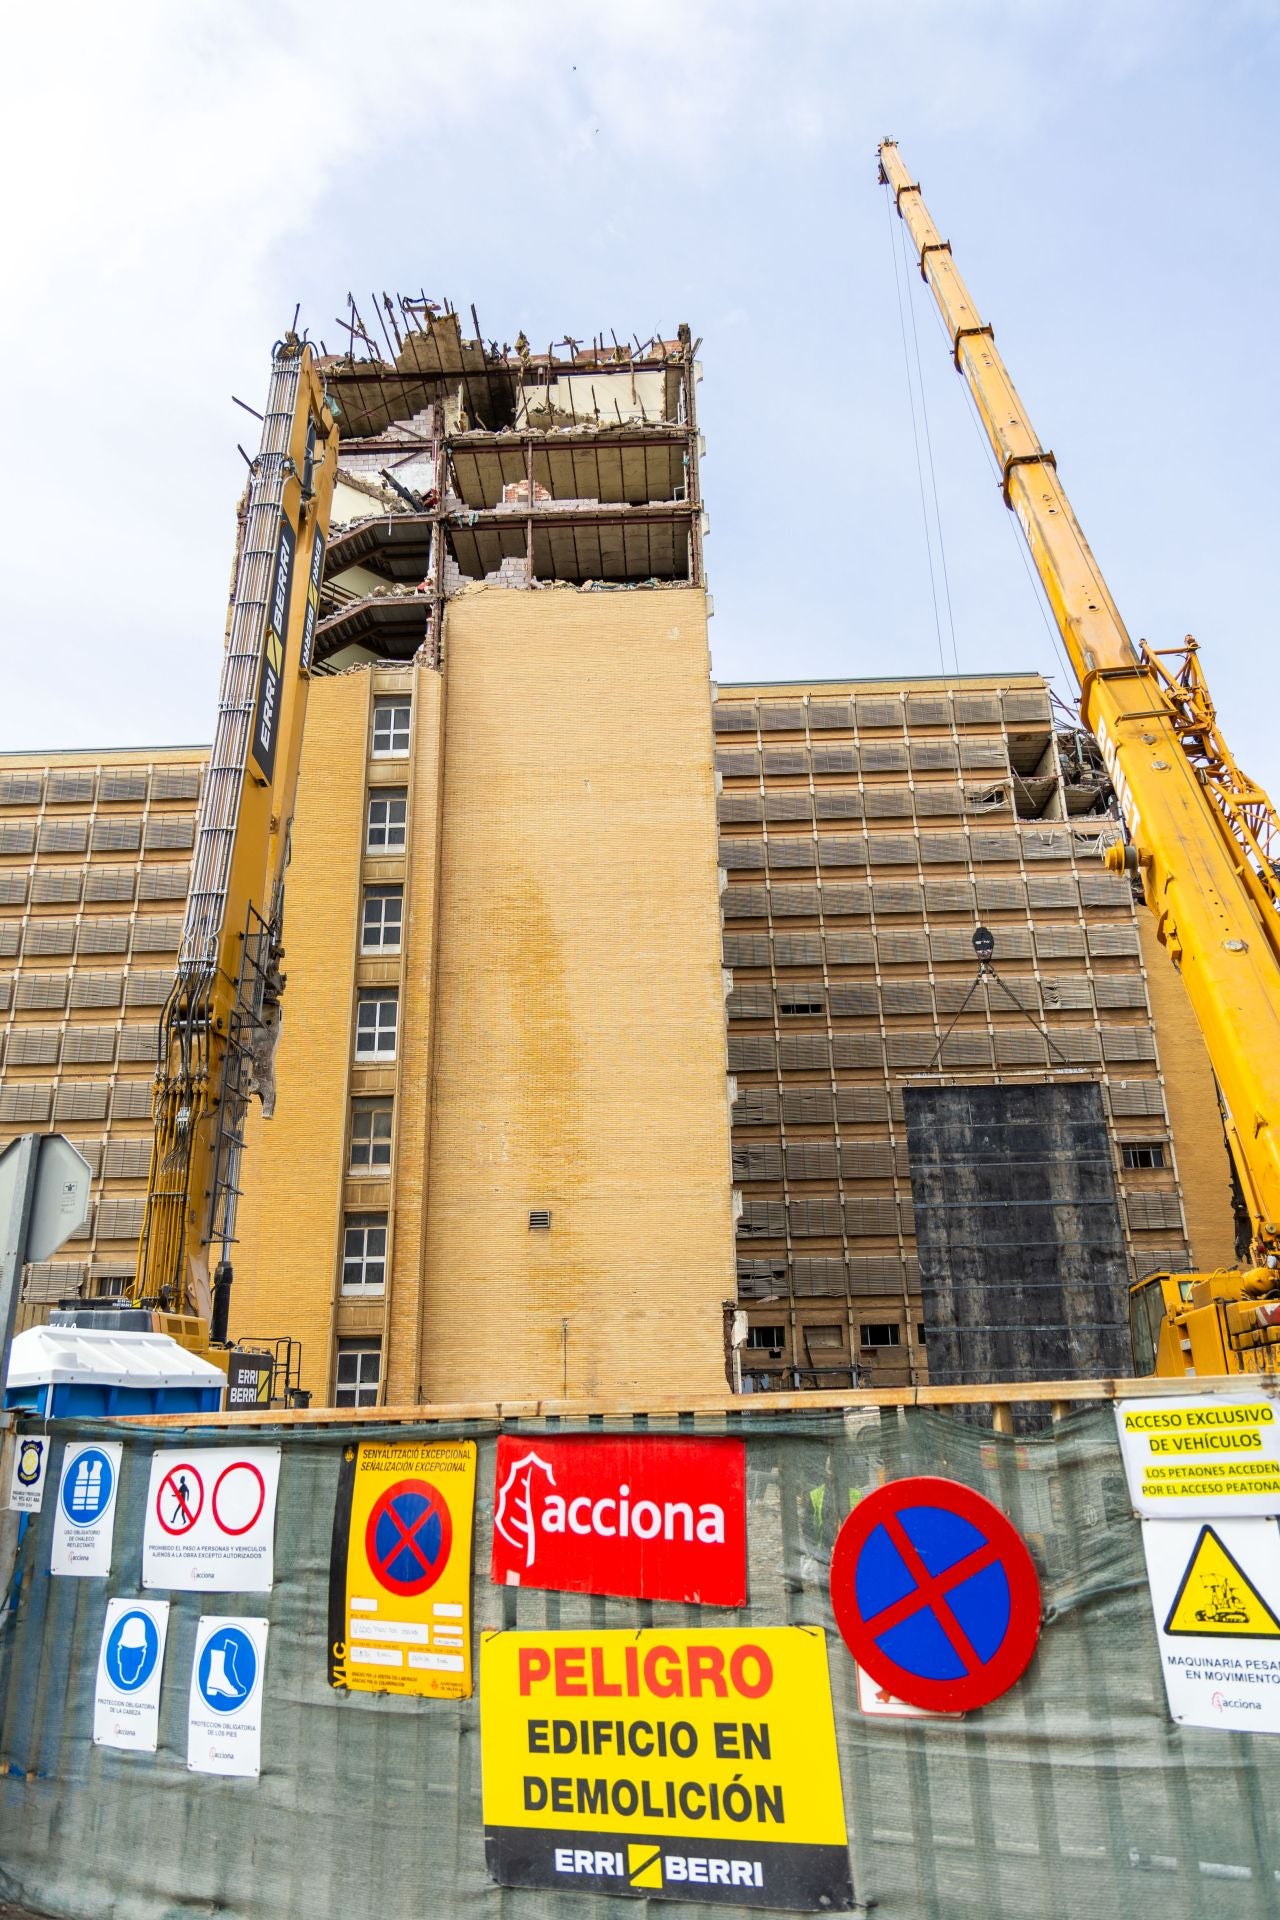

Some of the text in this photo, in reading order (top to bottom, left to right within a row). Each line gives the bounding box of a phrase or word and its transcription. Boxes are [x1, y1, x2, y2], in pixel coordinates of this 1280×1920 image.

[301, 537, 322, 667] ERRI BERRI
[260, 536, 291, 753] ERRI BERRI
[1097, 714, 1140, 839] BONET
[238, 1369, 258, 1384] ERRI
[230, 1388, 257, 1403] BERRI
[1125, 1408, 1273, 1429] ACCESO EXCLUSIVO
[1150, 1433, 1262, 1451] DE VEHÍCULOS
[363, 1448, 471, 1460] SENYALITZACIÓ EXCEPCIONAL
[361, 1461, 466, 1472] SEÑALIZACIÓN EXCEPCIONAL
[1146, 1464, 1280, 1478] LOS PETAONES ACCEDEN
[1142, 1481, 1280, 1495] POR EL ACCESO PEATONA
[541, 1484, 725, 1543] acciona
[333, 1642, 346, 1688] VLC
[1168, 1656, 1280, 1670] MAQUINARIA PESA
[518, 1644, 773, 1699] PELIGRO
[1186, 1670, 1280, 1684] EN MOVIMIENTO
[125, 1702, 155, 1710] OBLIGATORIA
[1223, 1698, 1262, 1710] acciona
[223, 1723, 256, 1731] OBLIGATORIA
[527, 1719, 771, 1760] EDIFICIO EN
[215, 1751, 234, 1759] acciona
[523, 1773, 785, 1824] DEMOLICIÓN
[554, 1848, 764, 1888] ERRI BERRI
